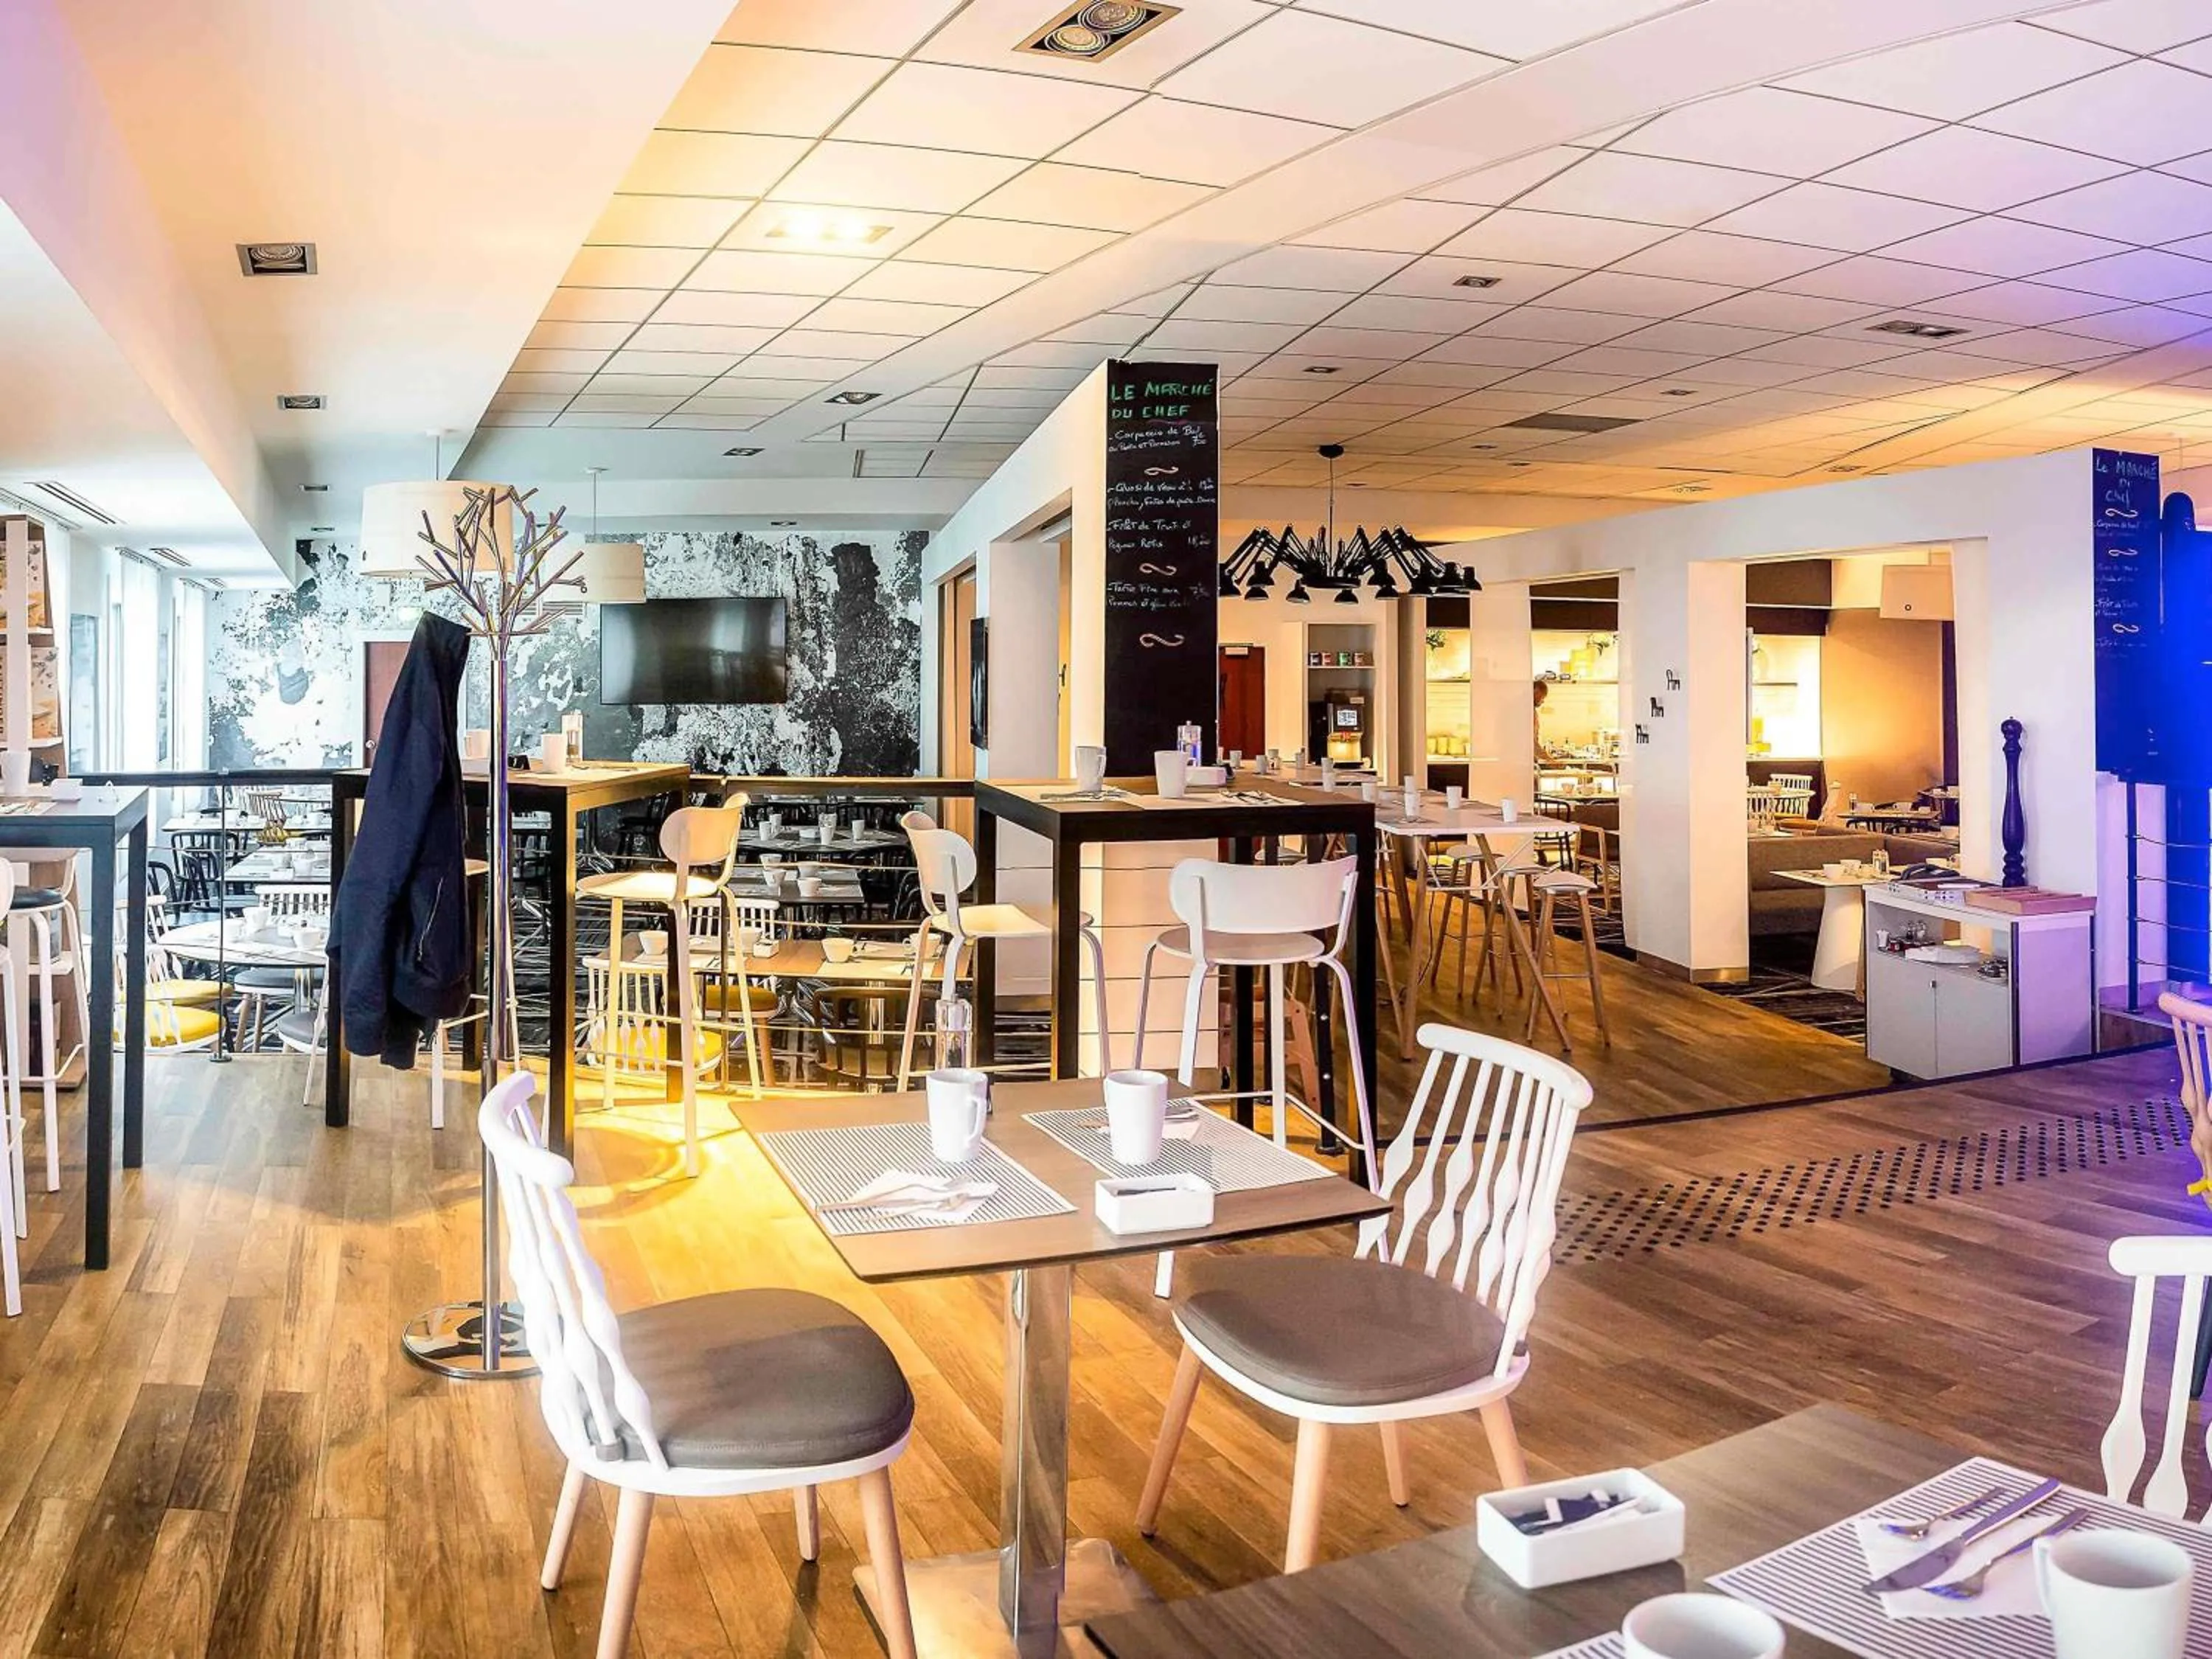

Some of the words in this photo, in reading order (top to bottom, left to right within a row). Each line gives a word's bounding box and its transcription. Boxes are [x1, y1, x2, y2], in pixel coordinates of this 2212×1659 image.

[1110, 383, 1135, 401] LE
[1144, 378, 1214, 397] MARCHÉ
[1111, 408, 1133, 419] DU
[1142, 405, 1191, 419] CHEF
[1138, 521, 1150, 530] de
